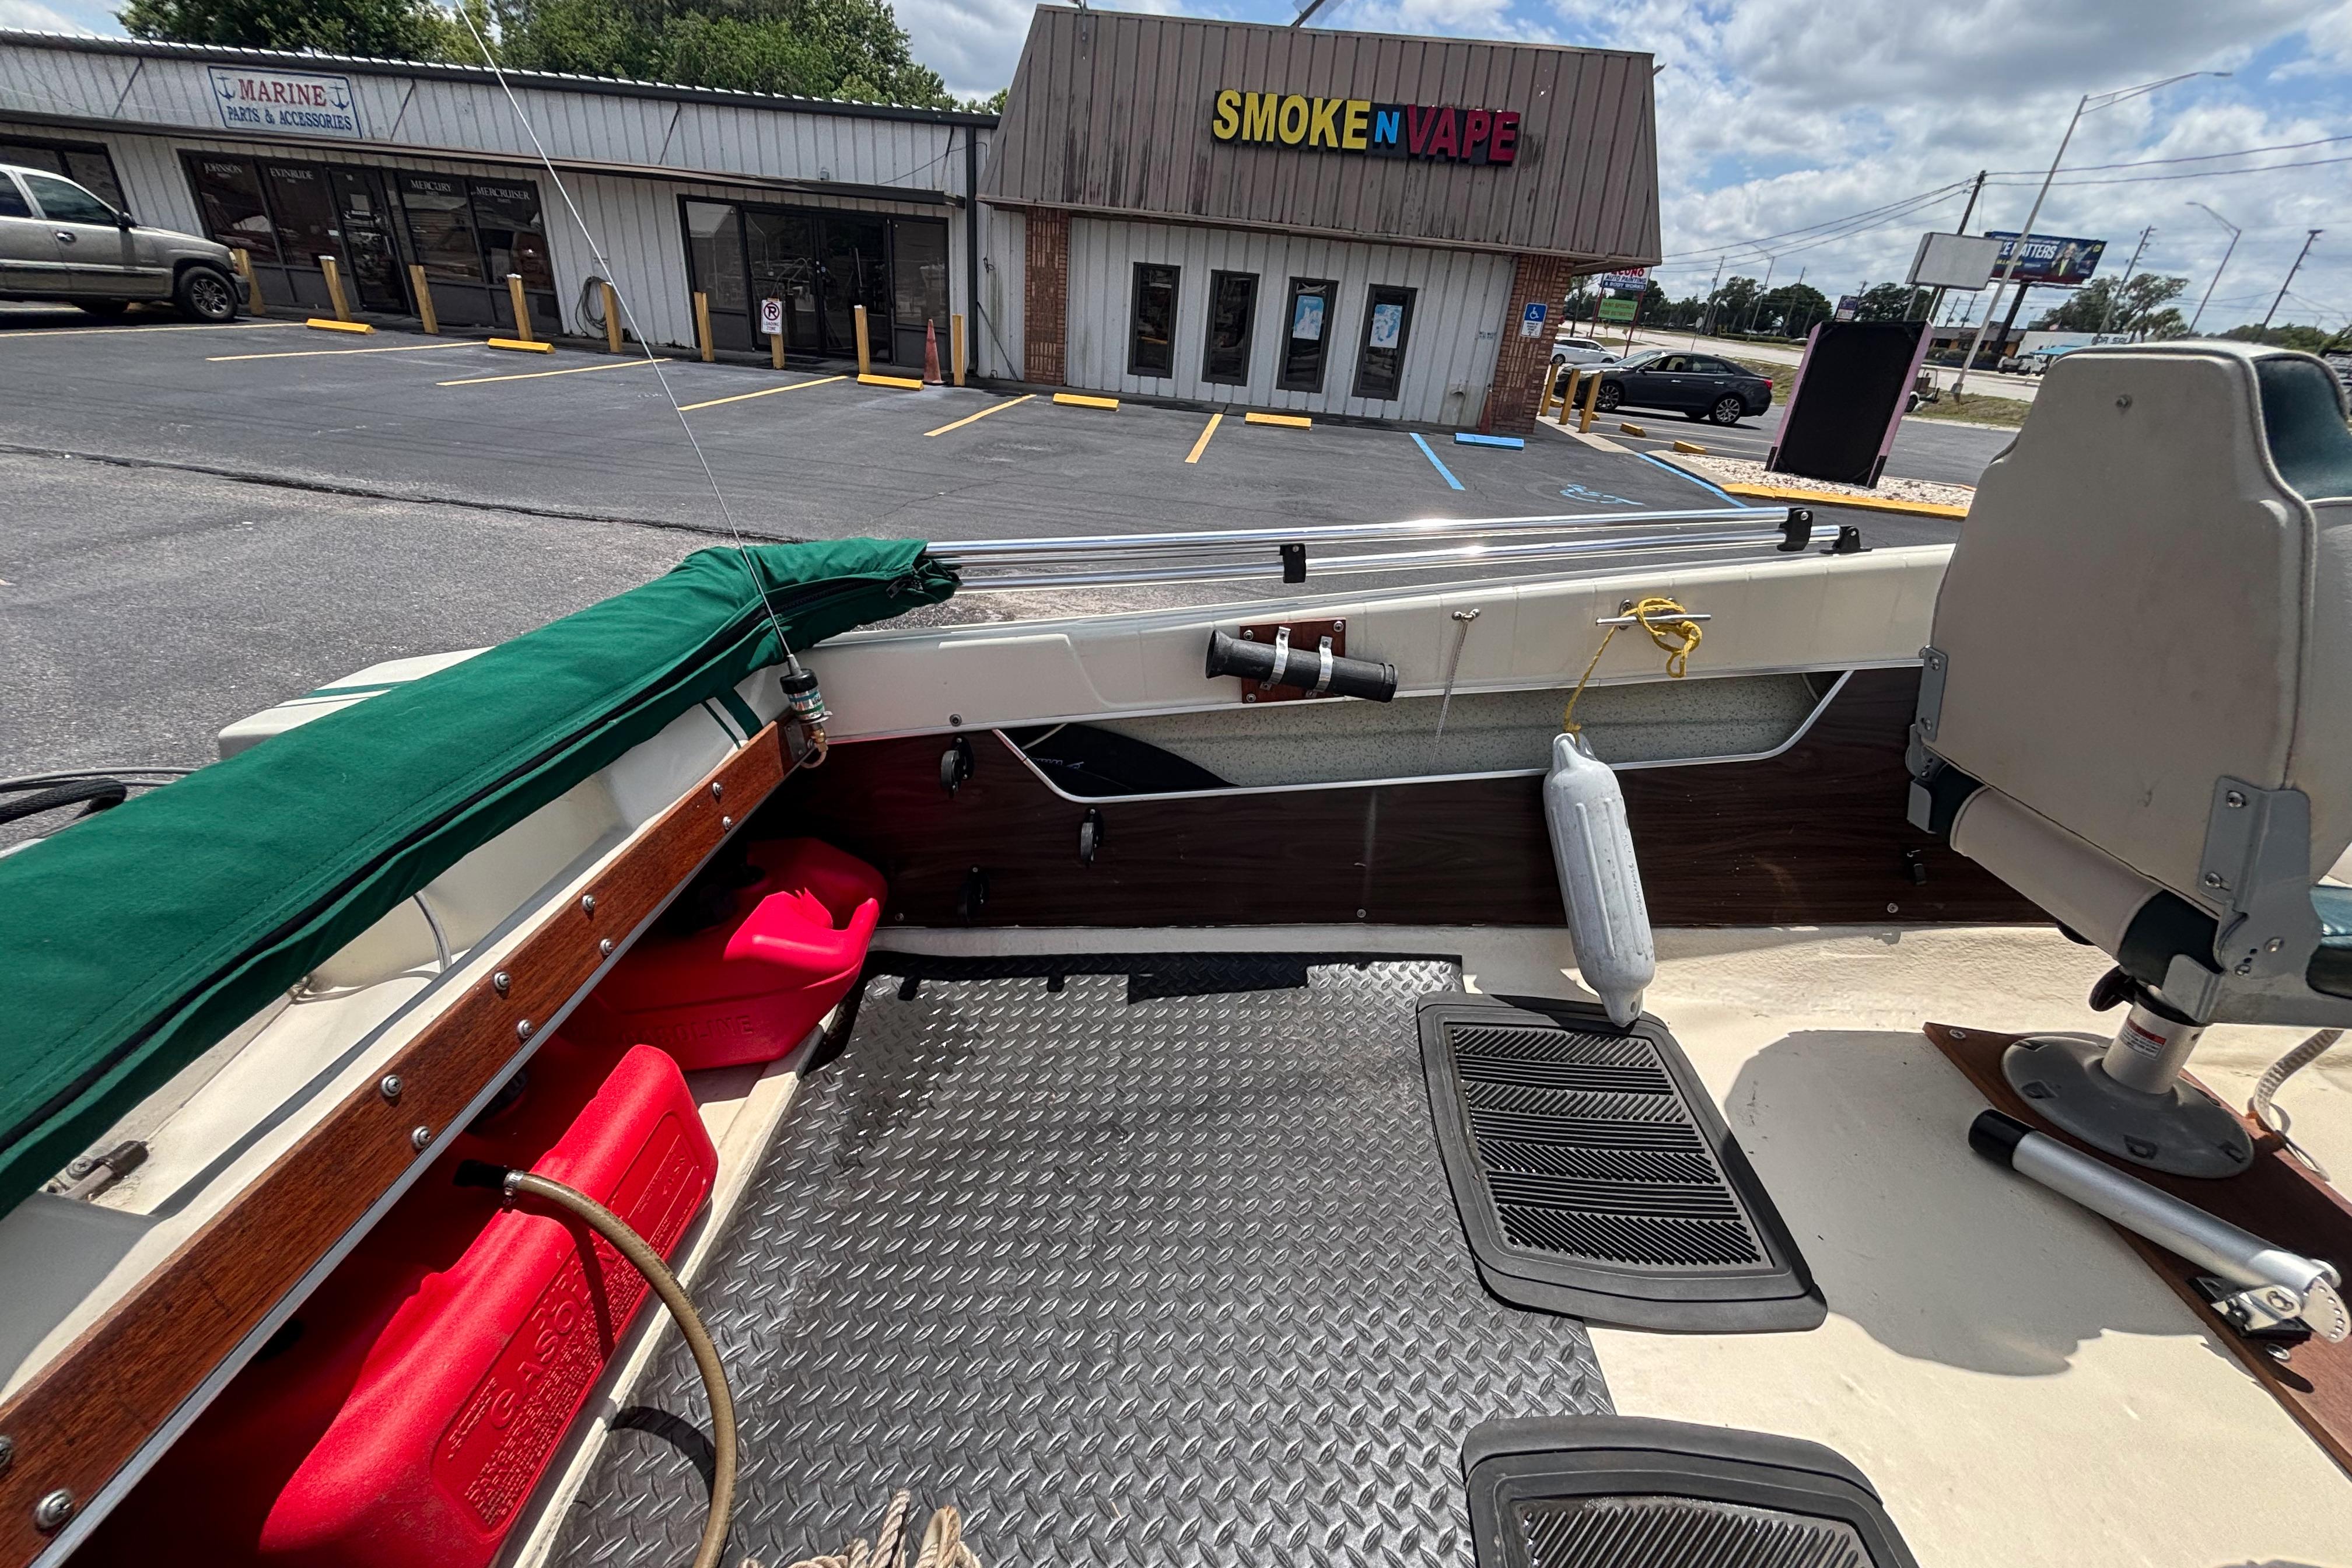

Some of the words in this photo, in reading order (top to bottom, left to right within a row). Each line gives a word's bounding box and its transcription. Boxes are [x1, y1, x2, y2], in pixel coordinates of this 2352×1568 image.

[238, 79, 327, 106] MARINE
[226, 106, 261, 123] PARTS
[265, 109, 275, 125] &
[279, 110, 353, 131] ACCESSORIES
[1213, 89, 1371, 150] SMOKE
[1374, 110, 1400, 144] N
[1406, 103, 1520, 162] VAPE
[204, 162, 243, 174] JOHNSON
[269, 167, 314, 180] EVINRUDE
[410, 180, 453, 192] MERCURY
[475, 186, 531, 201] MERCRUISER
[603, 1210, 622, 1227] USCG
[695, 1312, 712, 1340] SIERRA
